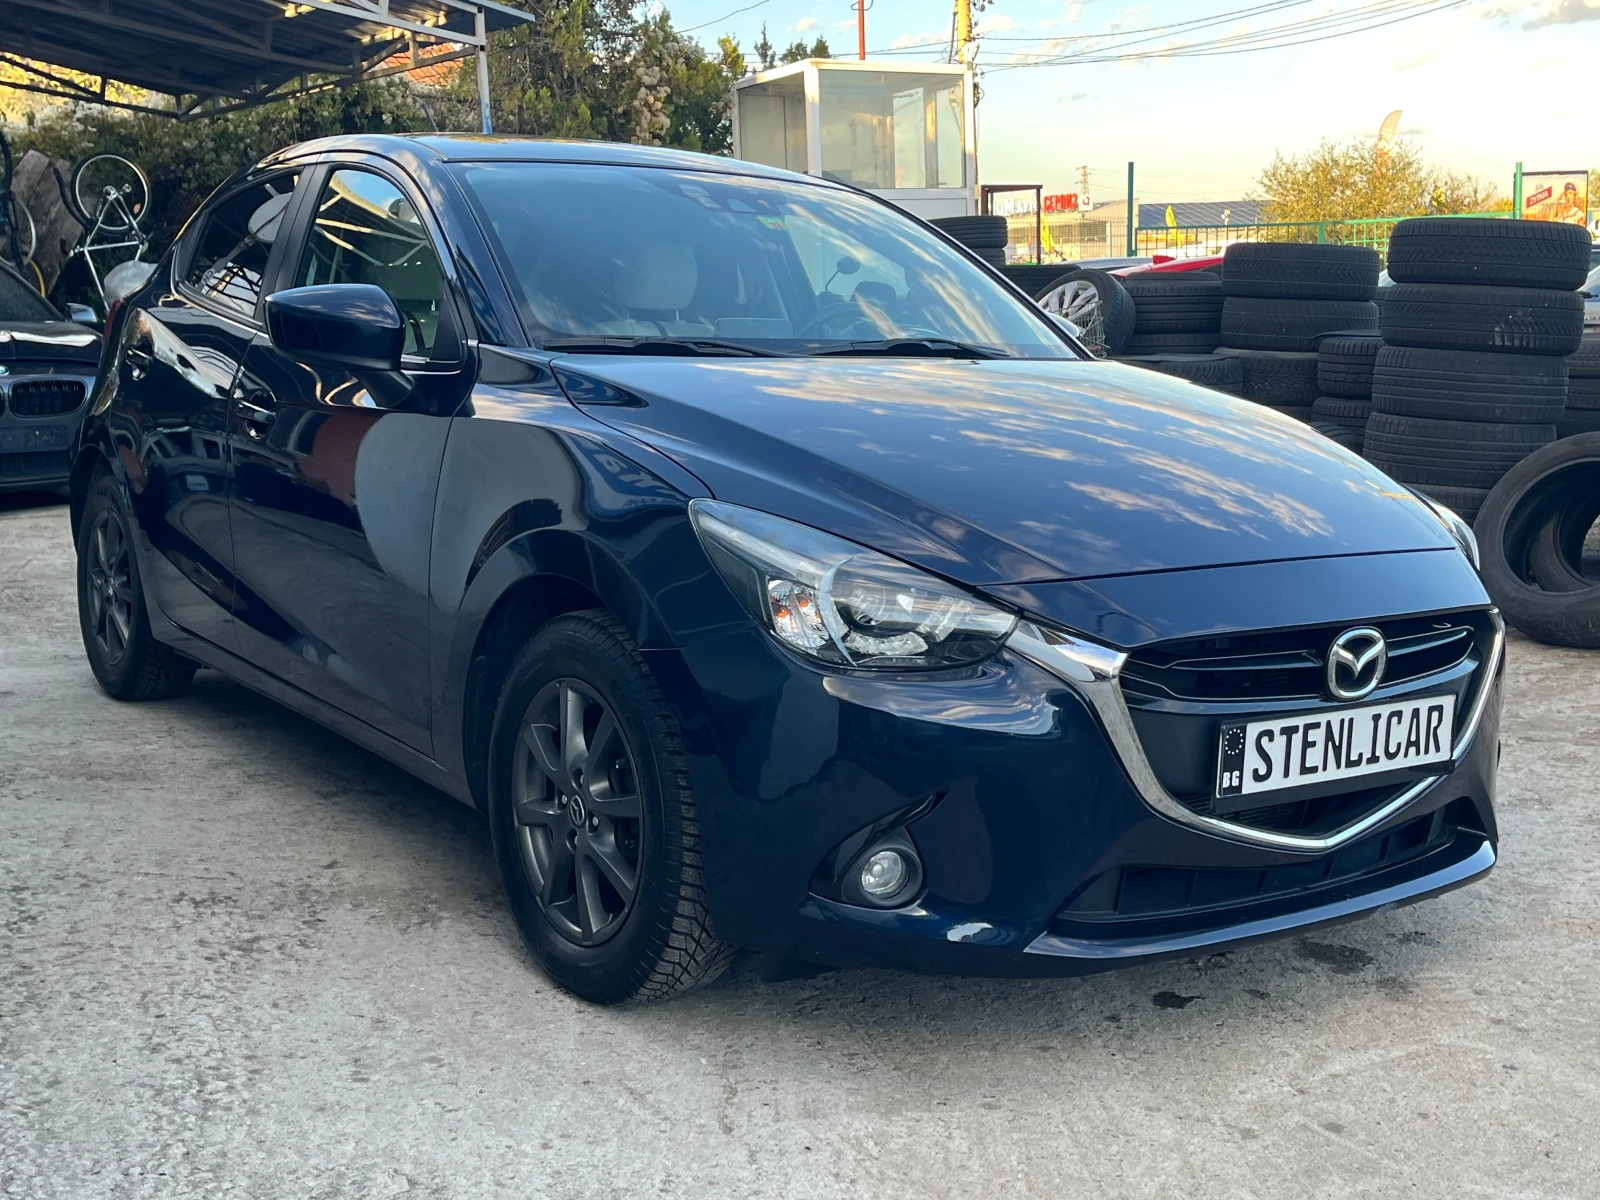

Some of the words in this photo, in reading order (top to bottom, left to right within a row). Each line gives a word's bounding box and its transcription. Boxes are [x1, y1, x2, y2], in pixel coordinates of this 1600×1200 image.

[1044, 193, 1078, 212] СЕРВИЗ
[1252, 704, 1444, 783] STENLICAR
[1222, 771, 1240, 788] BG
